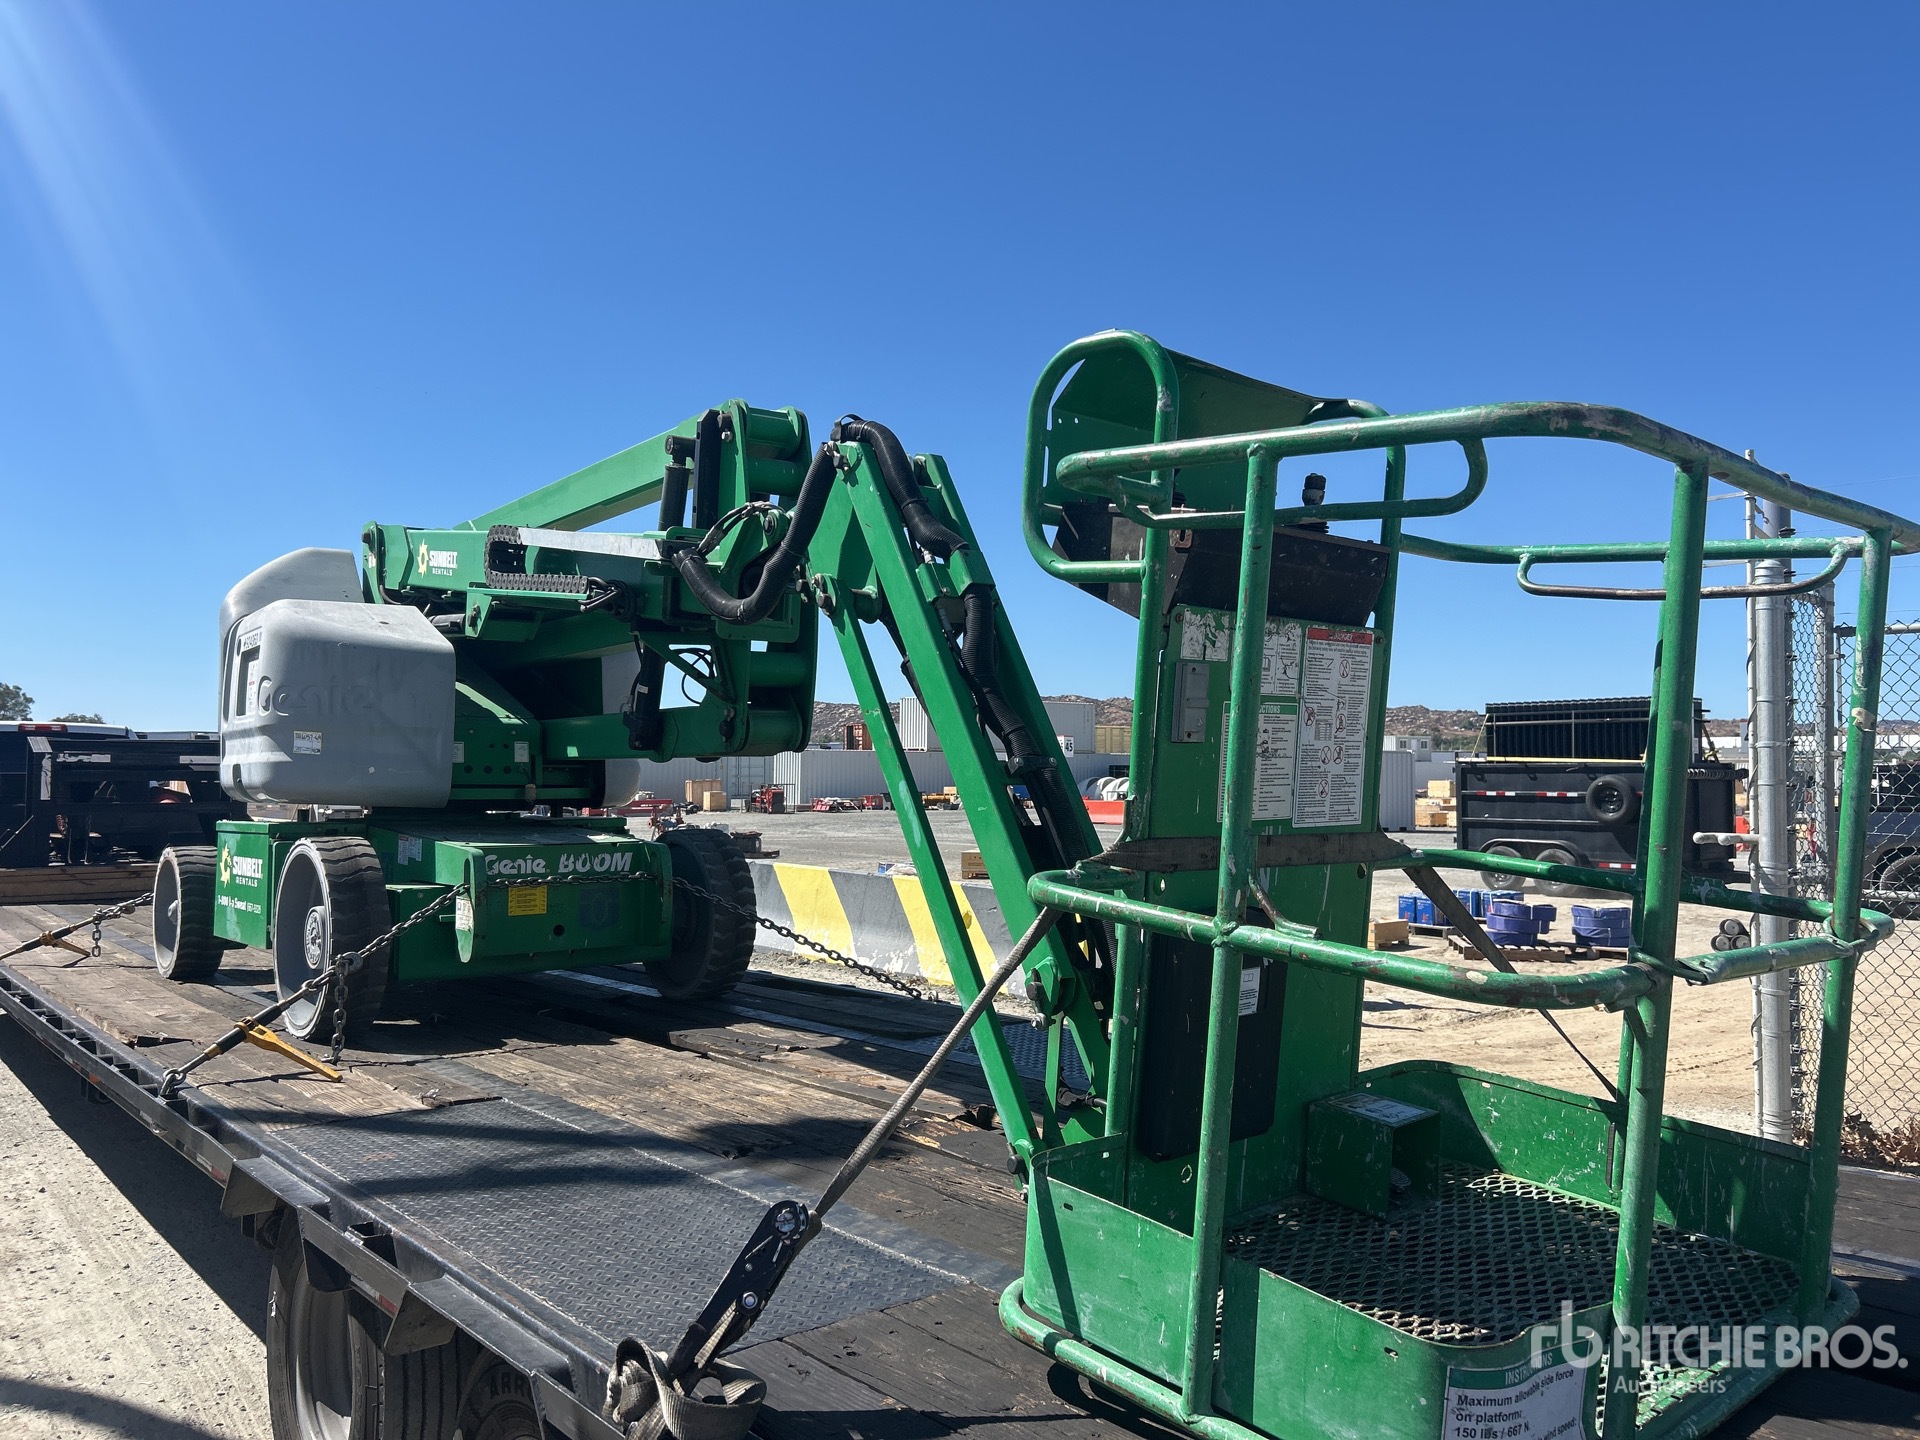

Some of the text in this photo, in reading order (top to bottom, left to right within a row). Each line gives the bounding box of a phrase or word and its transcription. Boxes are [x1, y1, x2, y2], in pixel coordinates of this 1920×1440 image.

[429, 550, 458, 569] SUNBELT
[432, 568, 453, 576] RENTALS
[1065, 742, 1073, 752] 45
[233, 856, 263, 879] SUNBELT
[485, 852, 633, 876] Genie BOOM
[236, 877, 258, 887] RENTALS
[1457, 1368, 1575, 1407] Maximum allowable side force
[1455, 1411, 1471, 1423] on
[1455, 1427, 1477, 1439] 150
[1480, 1427, 1498, 1439] lbs
[1507, 1424, 1522, 1438] 667
